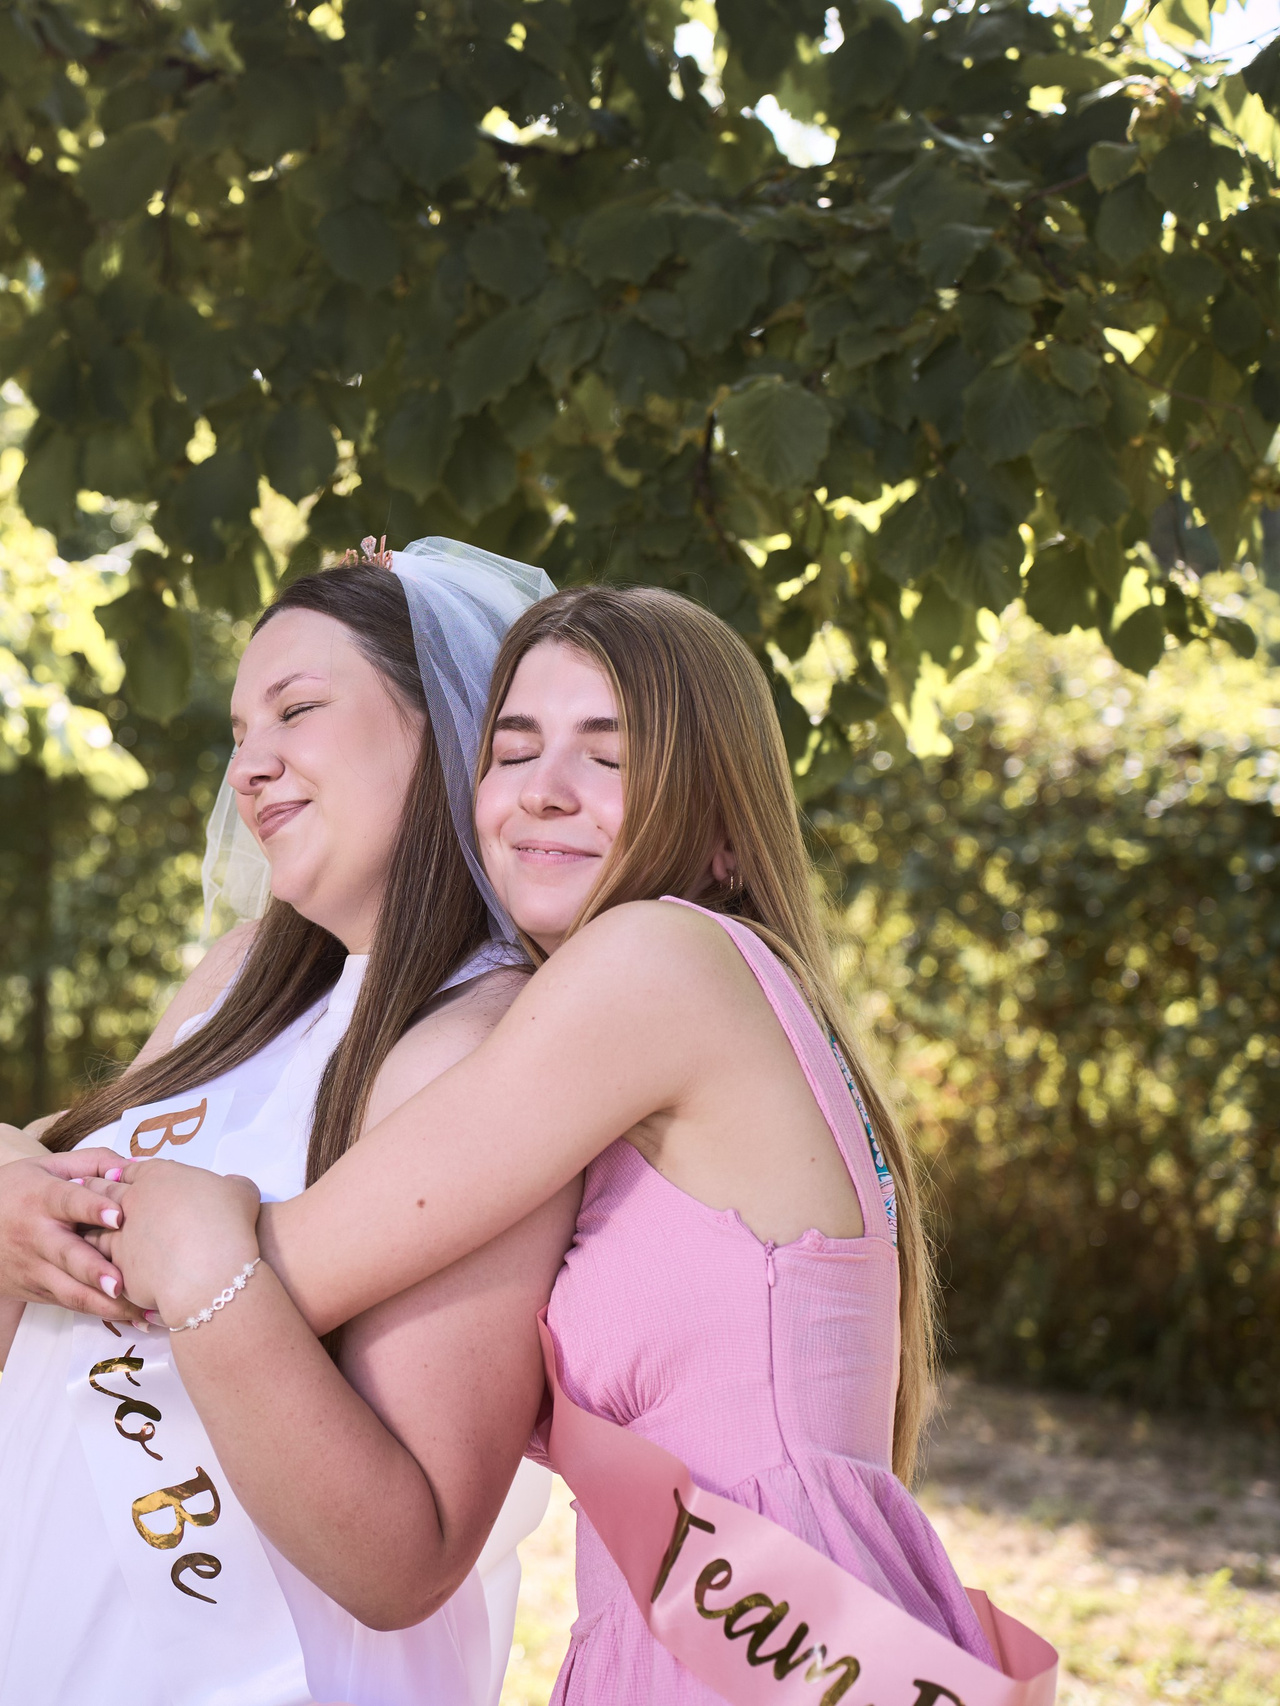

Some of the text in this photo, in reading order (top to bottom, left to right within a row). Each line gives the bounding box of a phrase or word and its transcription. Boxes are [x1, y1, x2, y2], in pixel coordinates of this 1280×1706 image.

[88, 1343, 223, 1605] to Be
[650, 1487, 874, 1706] Team
